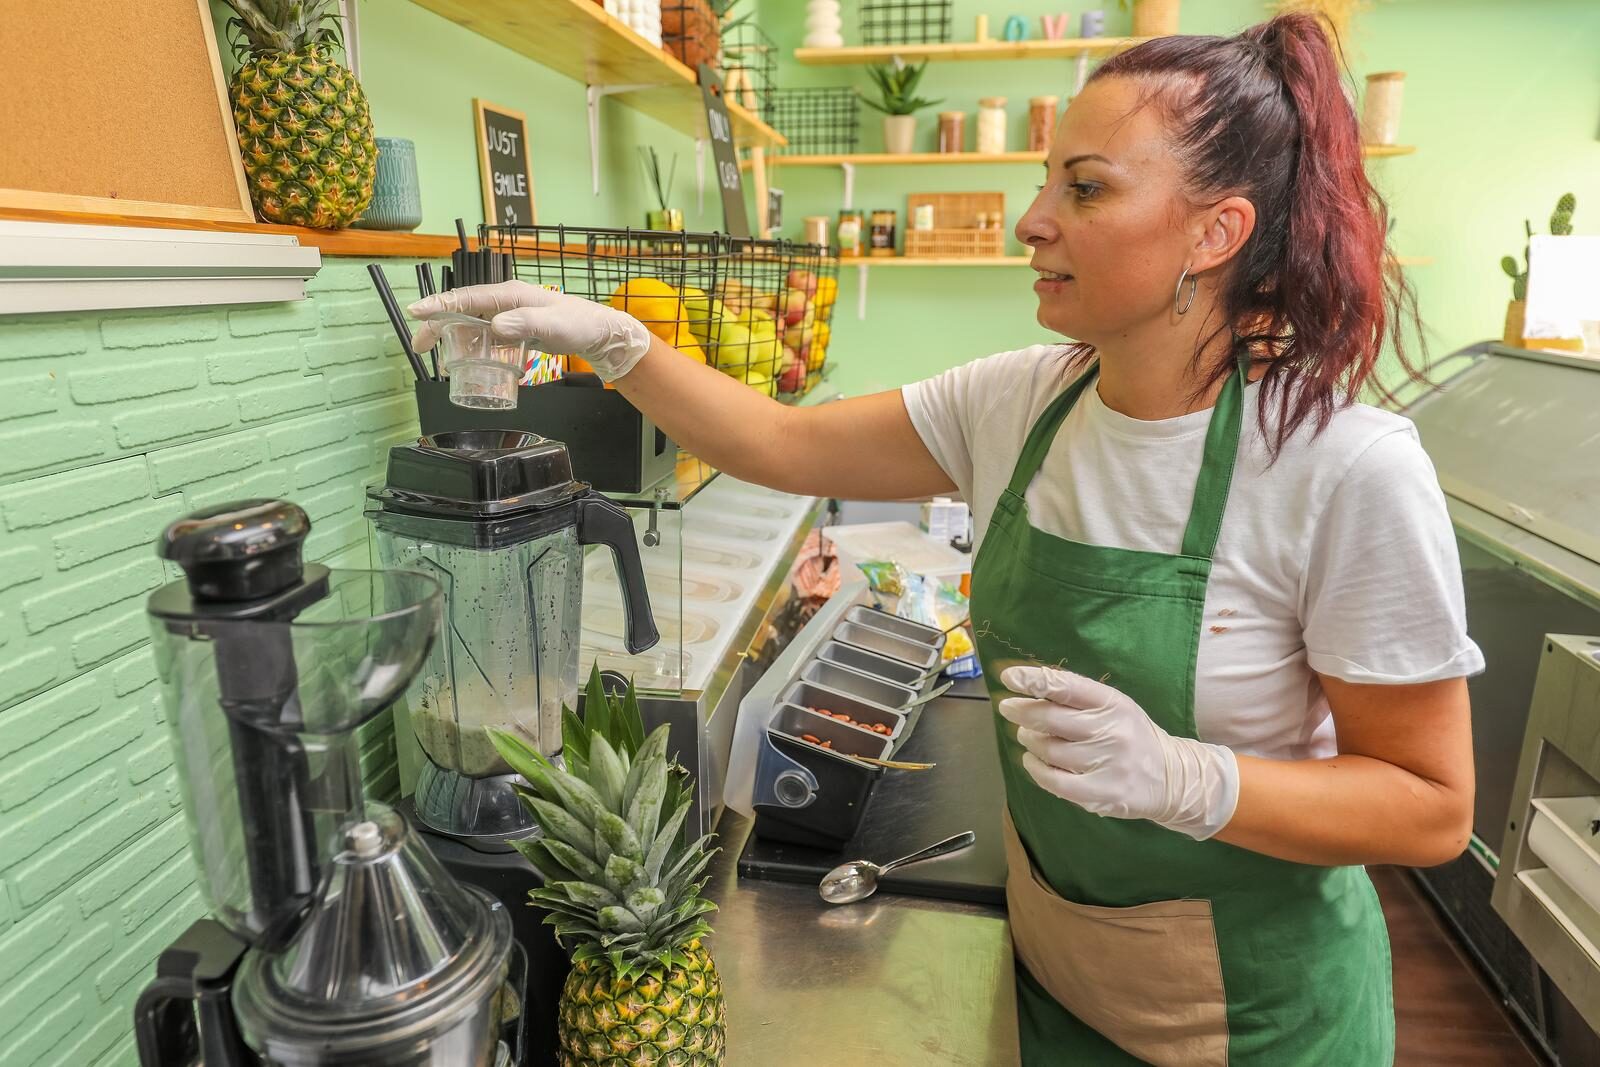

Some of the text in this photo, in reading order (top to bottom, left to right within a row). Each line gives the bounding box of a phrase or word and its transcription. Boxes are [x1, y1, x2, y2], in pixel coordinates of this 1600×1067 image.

[975, 11, 1104, 43] LOVE
[488, 125, 518, 157] JUST
[494, 171, 527, 197] SMILE
